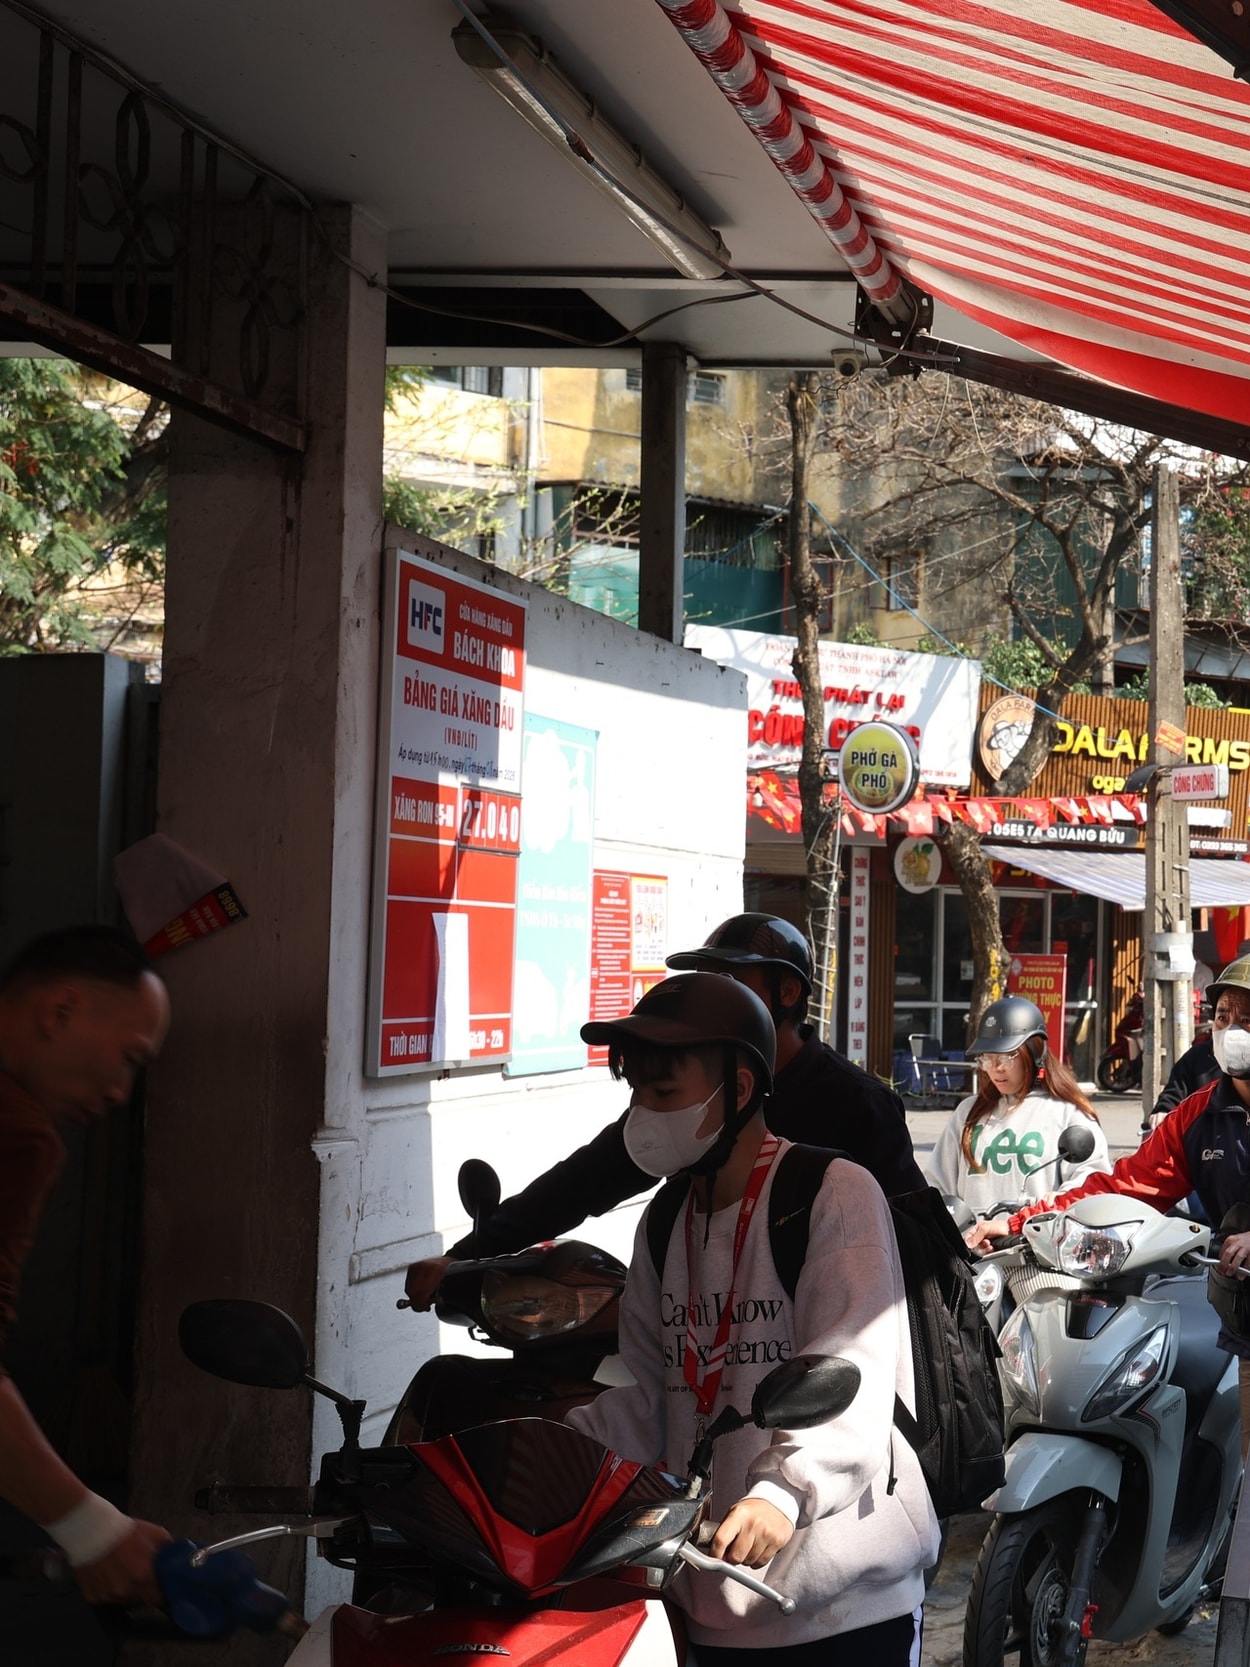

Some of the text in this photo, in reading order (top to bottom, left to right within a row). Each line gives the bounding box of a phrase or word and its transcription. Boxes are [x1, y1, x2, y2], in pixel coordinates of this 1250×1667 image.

[411, 598, 442, 636] HFC
[453, 628, 516, 678] BÁCH KHOA
[403, 669, 515, 731] BẢNG GIÁ XĂNG DẦU
[823, 684, 874, 704] PHÁT
[877, 691, 906, 712] LẠI
[748, 704, 805, 747] CÔN
[398, 743, 407, 762] Áp
[407, 748, 423, 766] dụng
[1053, 721, 1136, 760] DALA
[851, 747, 898, 768] PHỞ GÀ
[861, 767, 887, 788] PHỐ
[1174, 770, 1214, 793] CÔNG CHỨNG
[394, 792, 416, 822] XĂNG
[417, 800, 433, 824] RON
[462, 798, 520, 843] 27.040
[1047, 826, 1097, 842] QUANG
[1100, 826, 1125, 844] BỬU
[1018, 976, 1055, 989] PHOTO
[1040, 991, 1062, 1008] THỰC
[390, 1031, 427, 1056] THỜI GIAN
[969, 1123, 1046, 1176] Lee
[675, 1334, 792, 1369] Exerience
[433, 1641, 511, 1657] HONDA
